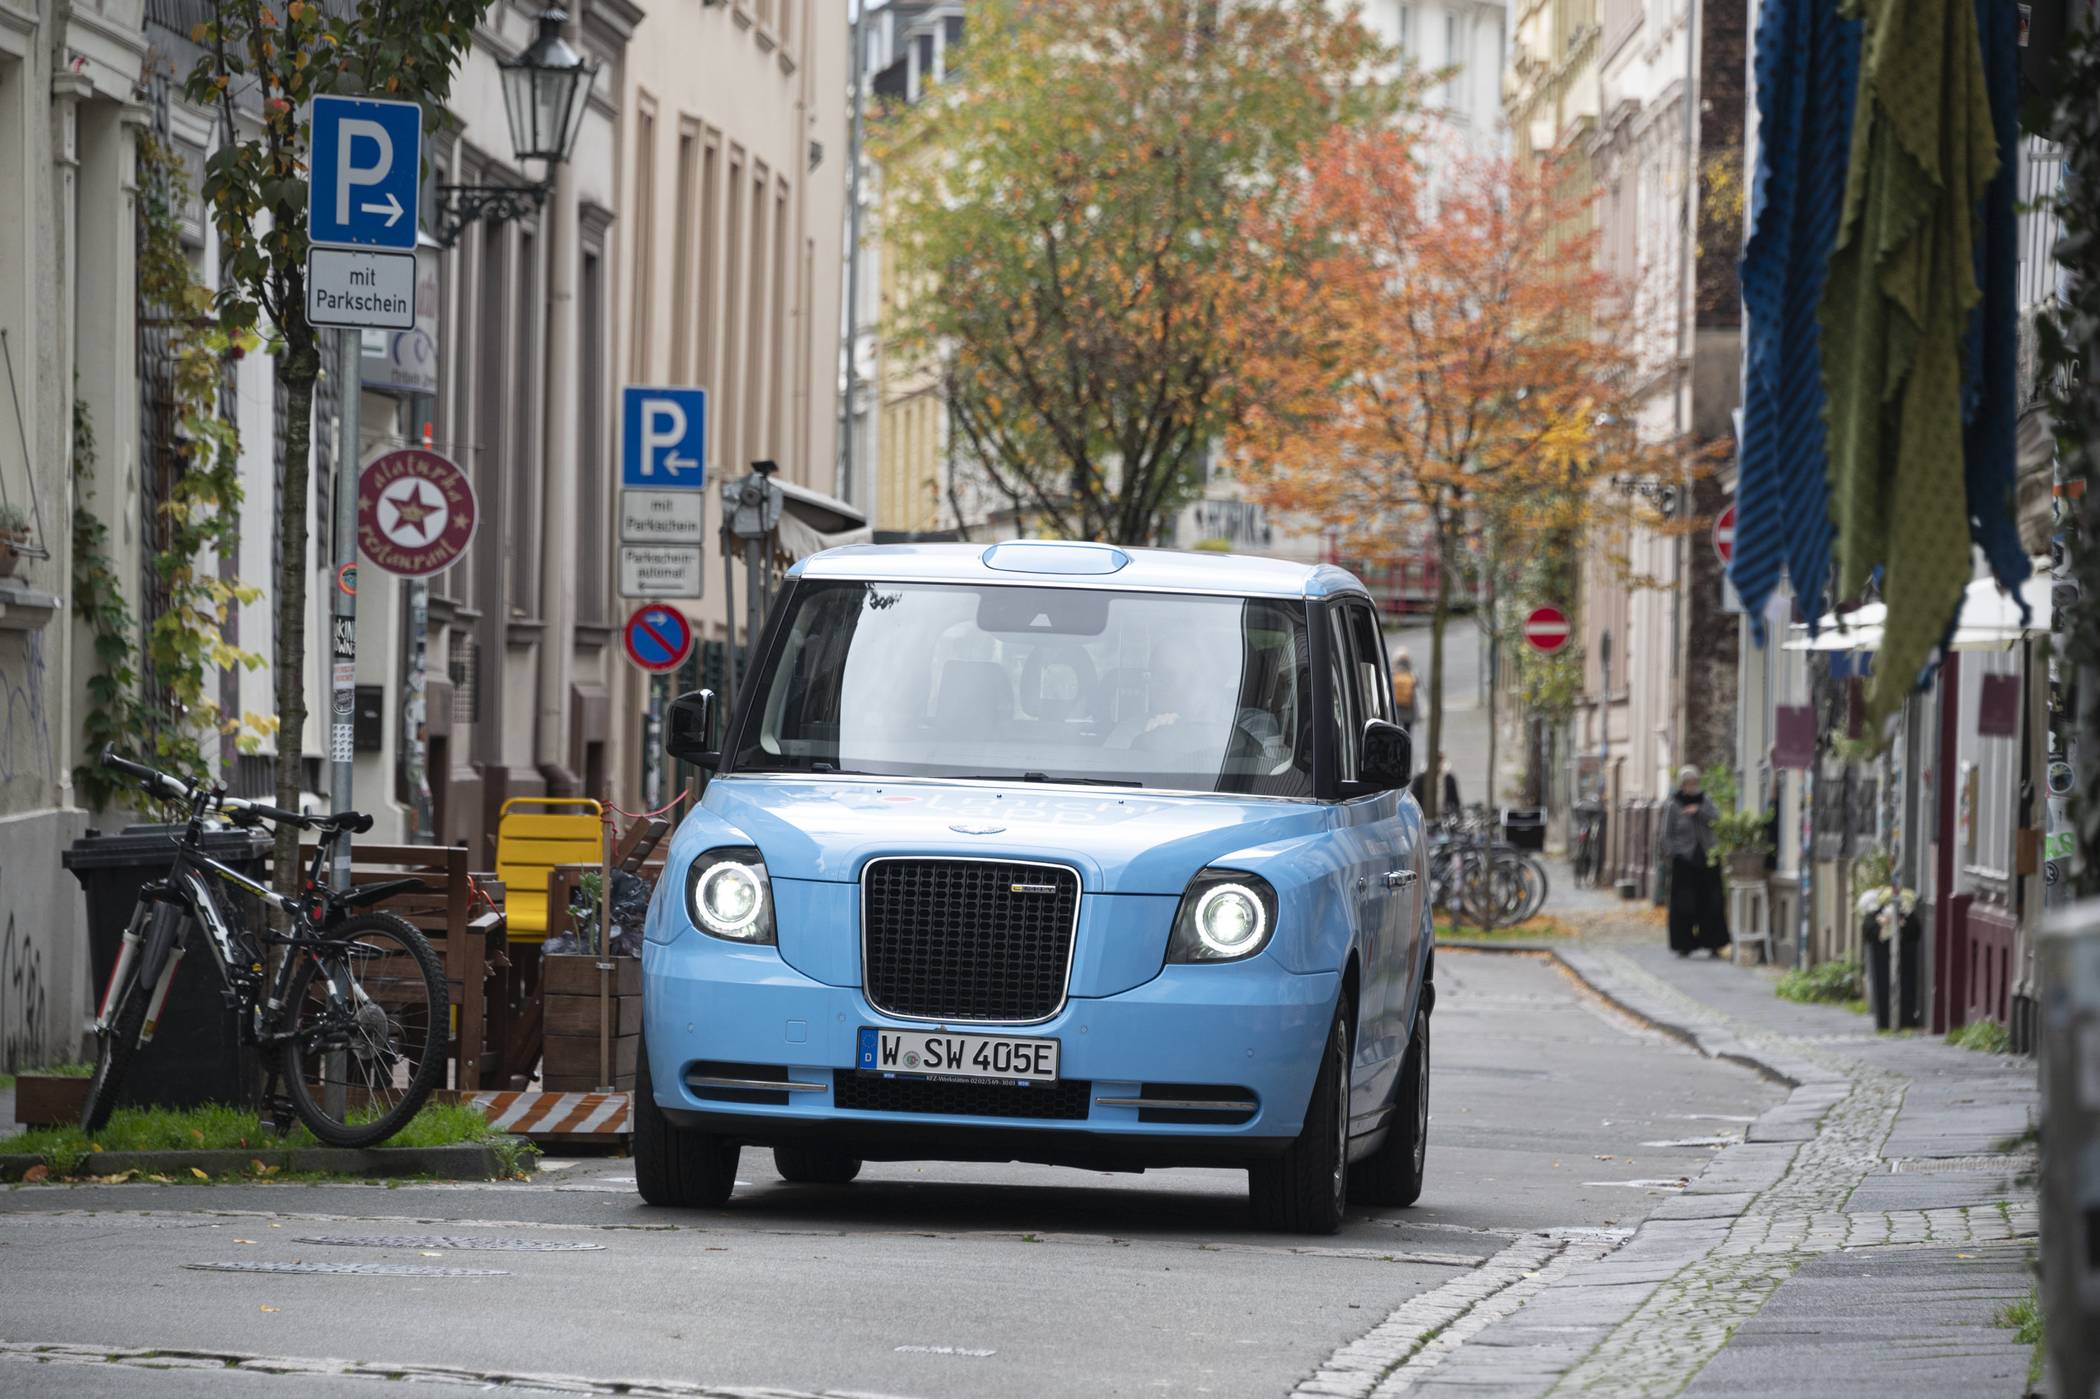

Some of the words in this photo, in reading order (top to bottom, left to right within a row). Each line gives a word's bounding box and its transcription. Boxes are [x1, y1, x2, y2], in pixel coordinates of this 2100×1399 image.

[336, 118, 394, 225] P
[350, 268, 376, 286] mit
[316, 289, 407, 313] Parkschein
[641, 399, 688, 476] P
[373, 453, 463, 503] alaturka
[651, 499, 674, 512] mit
[626, 516, 698, 533] Parkschein
[360, 525, 458, 570] restaurant
[638, 567, 684, 580] automat
[882, 1035, 901, 1065] W
[924, 1038, 965, 1069] SW
[973, 1041, 1053, 1075] 405E
